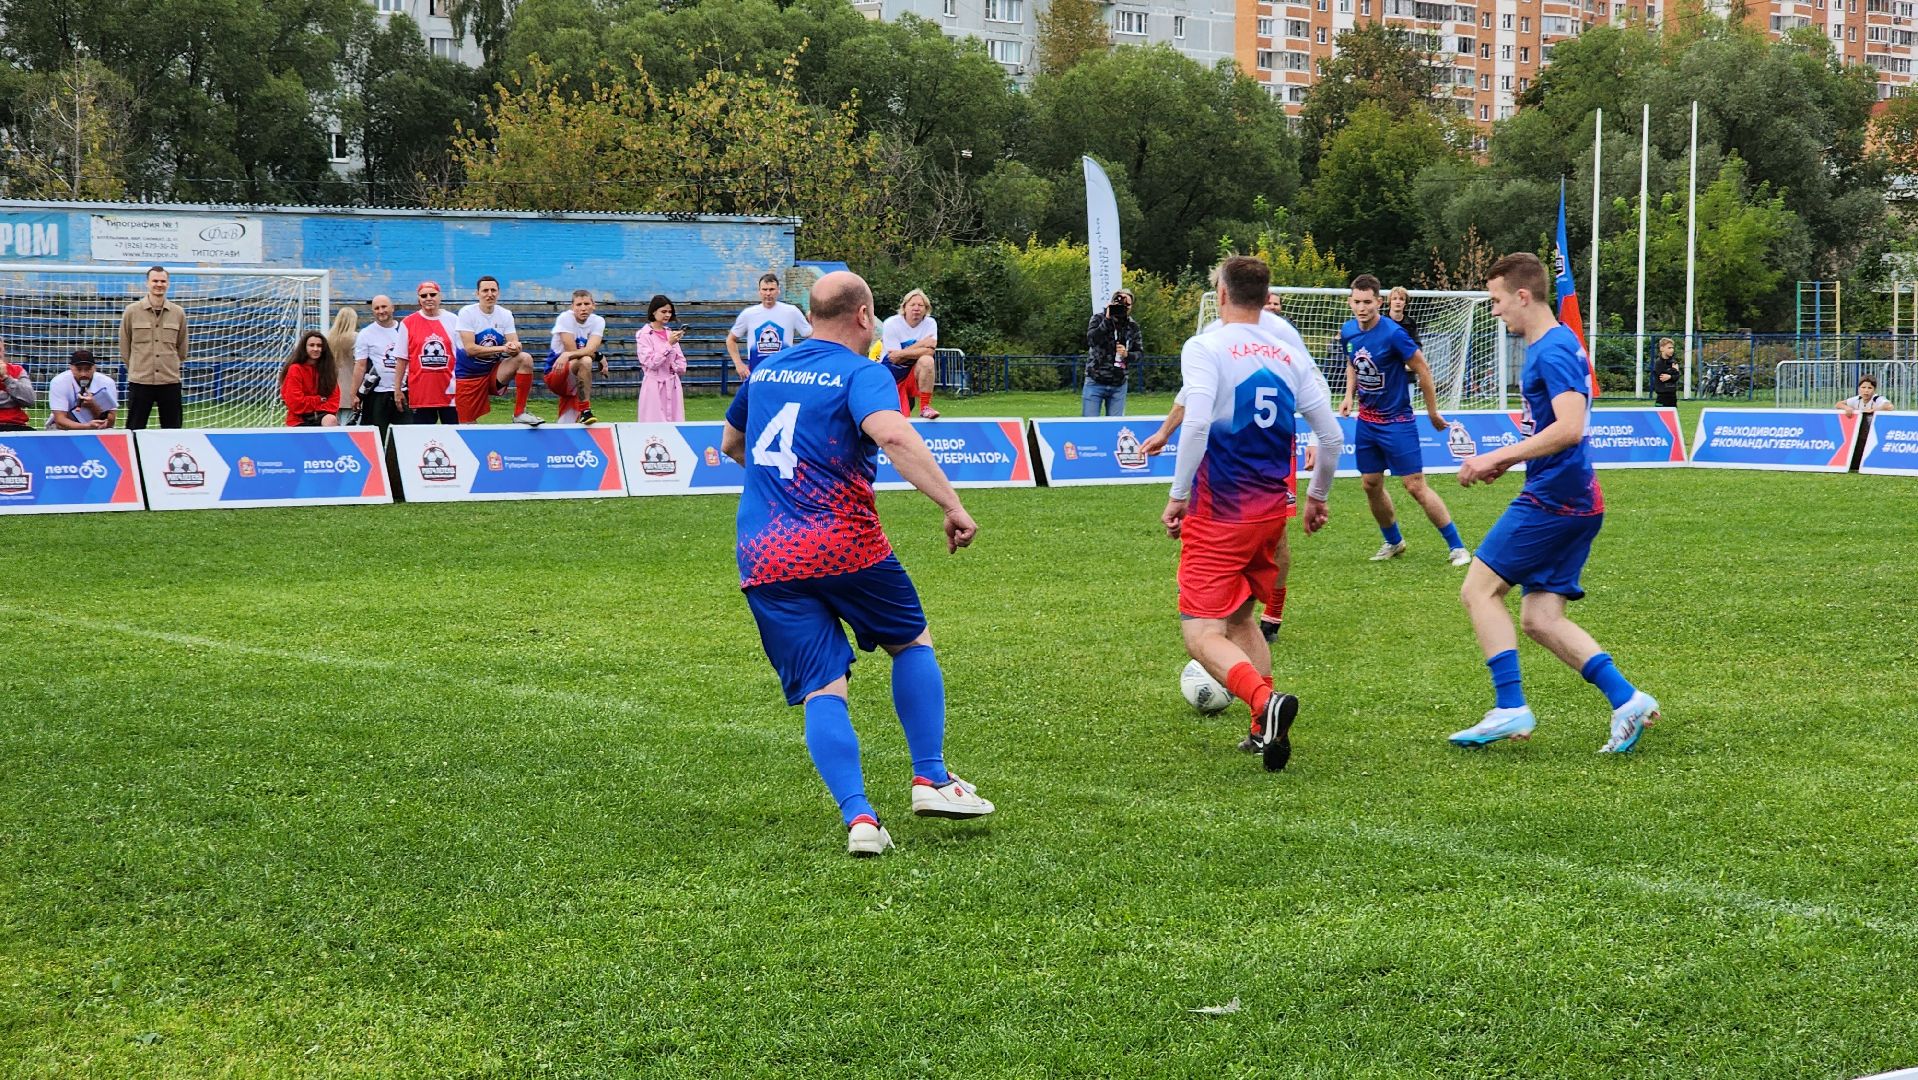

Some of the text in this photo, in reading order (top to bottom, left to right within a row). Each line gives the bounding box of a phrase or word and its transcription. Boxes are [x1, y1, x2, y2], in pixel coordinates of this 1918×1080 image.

[1228, 343, 1292, 366] КАРЯКА
[818, 372, 844, 388] С.А.
[1253, 386, 1279, 429] 5
[1713, 425, 1805, 438] #ВЫХОДИВОДВОР
[1884, 429, 1918, 441] #ВЫХ
[751, 401, 801, 480] 4
[1710, 437, 1836, 451] #КОМАНДАГУБЕРНАТОРА
[1881, 442, 1918, 454] #КОМ
